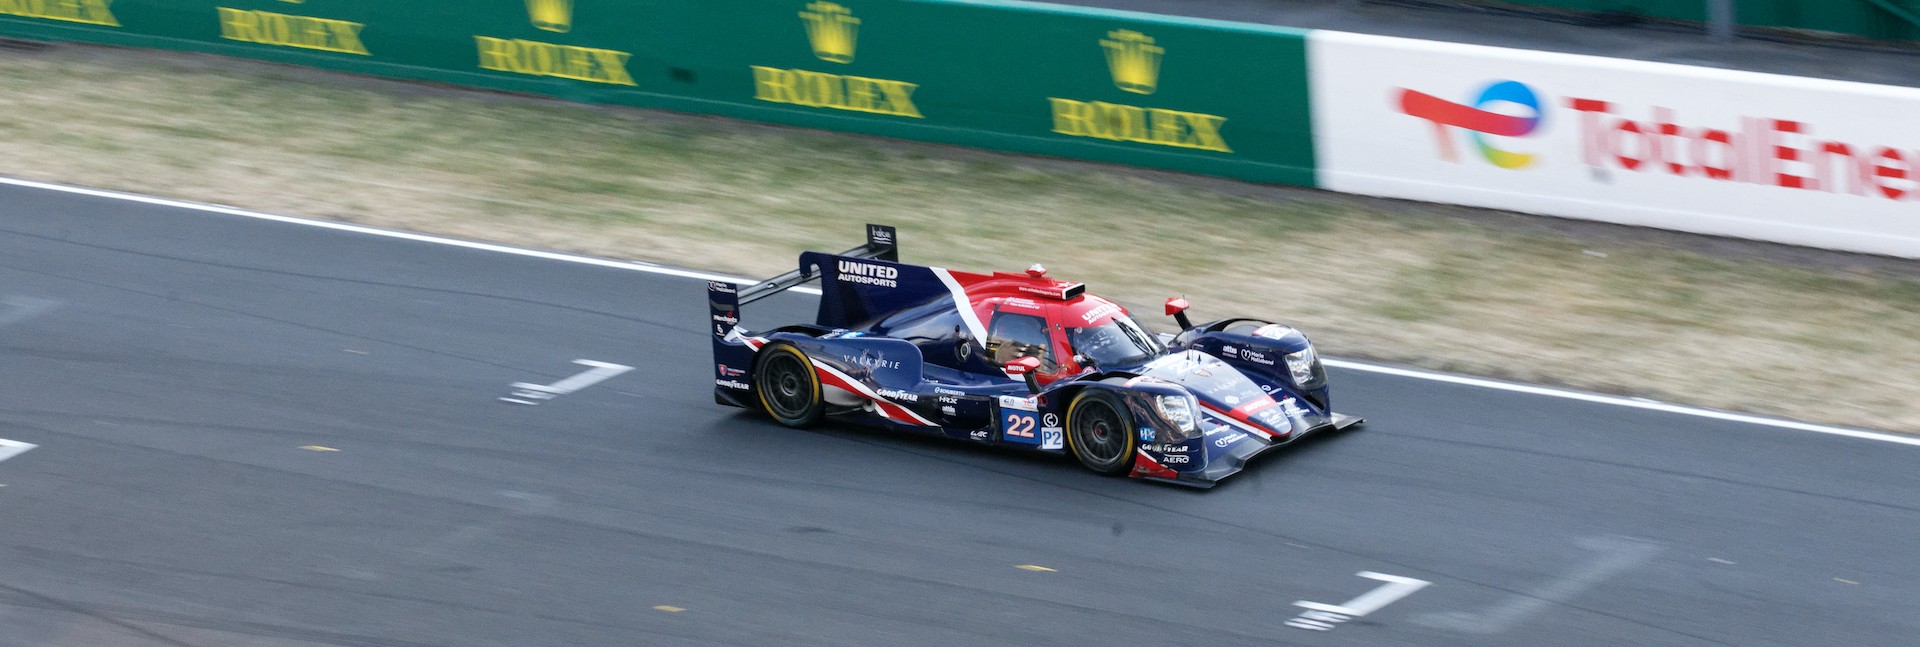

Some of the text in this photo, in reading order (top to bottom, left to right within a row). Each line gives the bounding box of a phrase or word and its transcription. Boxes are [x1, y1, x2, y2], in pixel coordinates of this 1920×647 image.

[217, 7, 370, 57] ROLEX
[474, 35, 637, 87] ROLEX
[751, 64, 924, 119] ROLEX
[1048, 97, 1232, 153] ROLEX
[1562, 96, 1920, 200] TotalEne
[838, 260, 898, 279] UNITED
[838, 273, 897, 288] AUTOSPORTS
[843, 354, 900, 370] VALKYRIE
[1007, 364, 1026, 372] MOTUL
[876, 388, 918, 402] GOODYEAR
[1006, 414, 1036, 439] 22
[1043, 430, 1062, 446] P2
[1162, 455, 1190, 464] AERO
